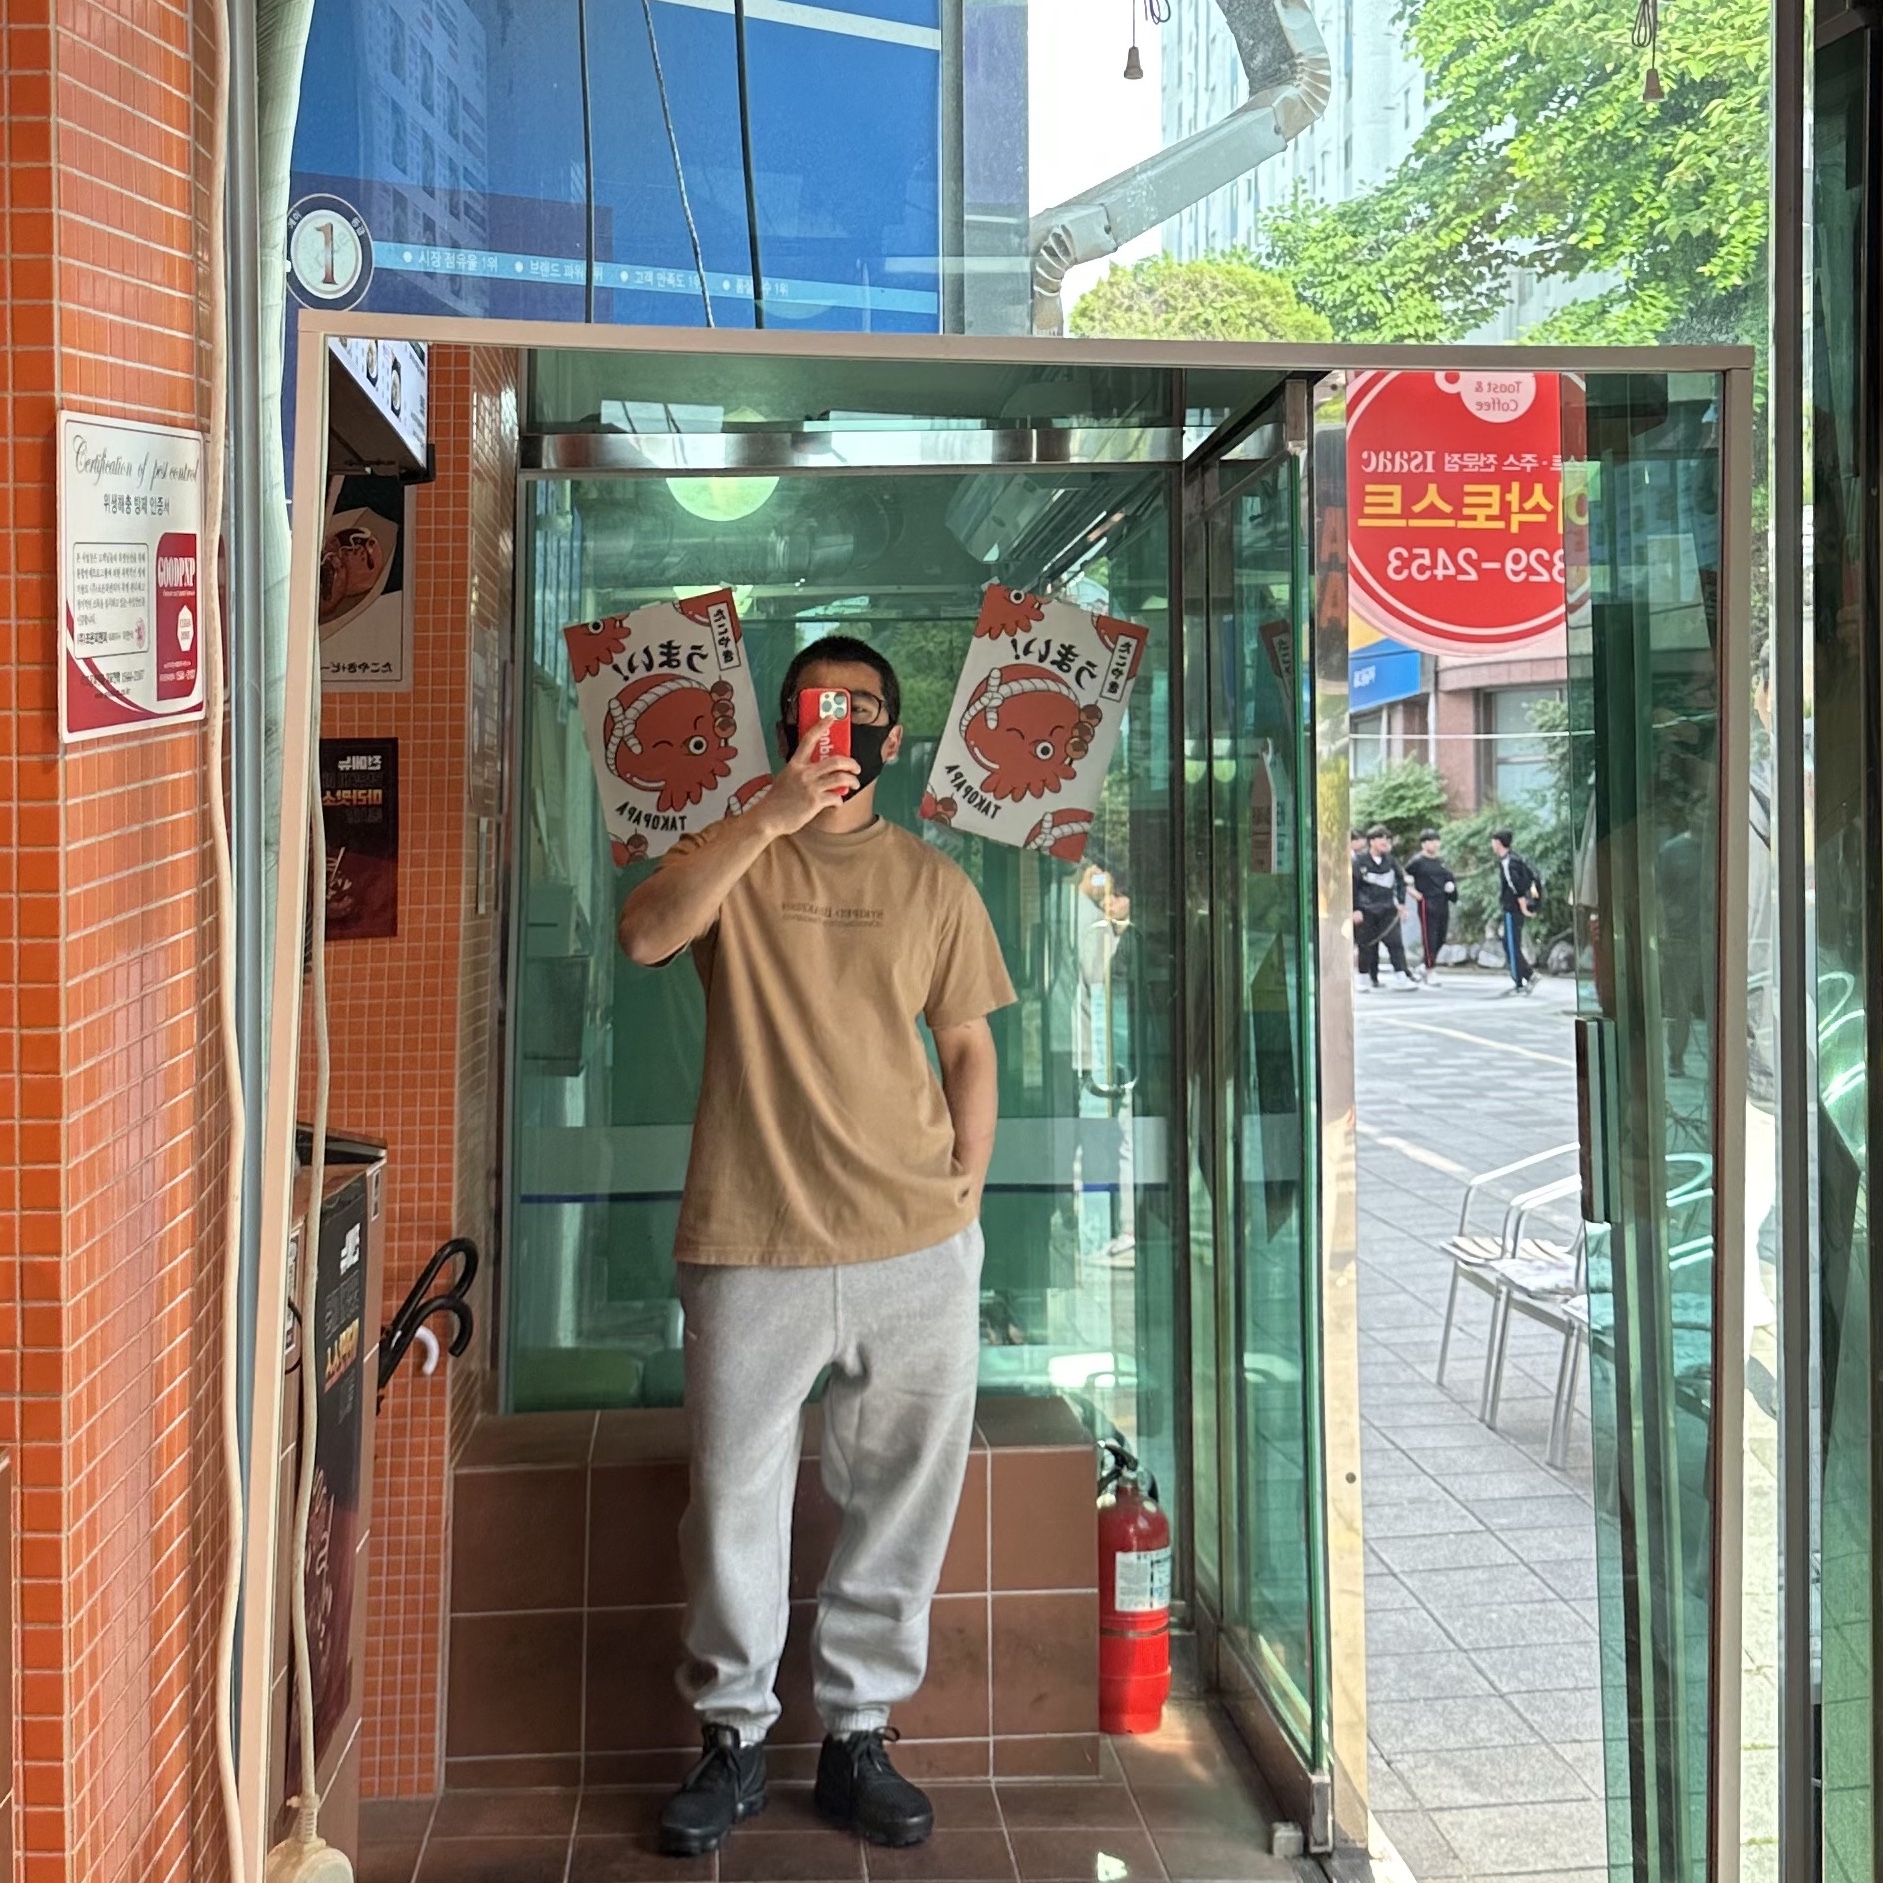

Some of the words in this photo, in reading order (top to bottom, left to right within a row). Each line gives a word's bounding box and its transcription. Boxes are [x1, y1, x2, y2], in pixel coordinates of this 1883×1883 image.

[313, 221, 339, 286] 1
[418, 250, 441, 268] 시장
[73, 434, 133, 487] Certification
[136, 451, 150, 490] of
[169, 459, 200, 483] control
[103, 493, 132, 515] 위생해충
[133, 495, 148, 516] 방제
[150, 496, 171, 516] 인증서
